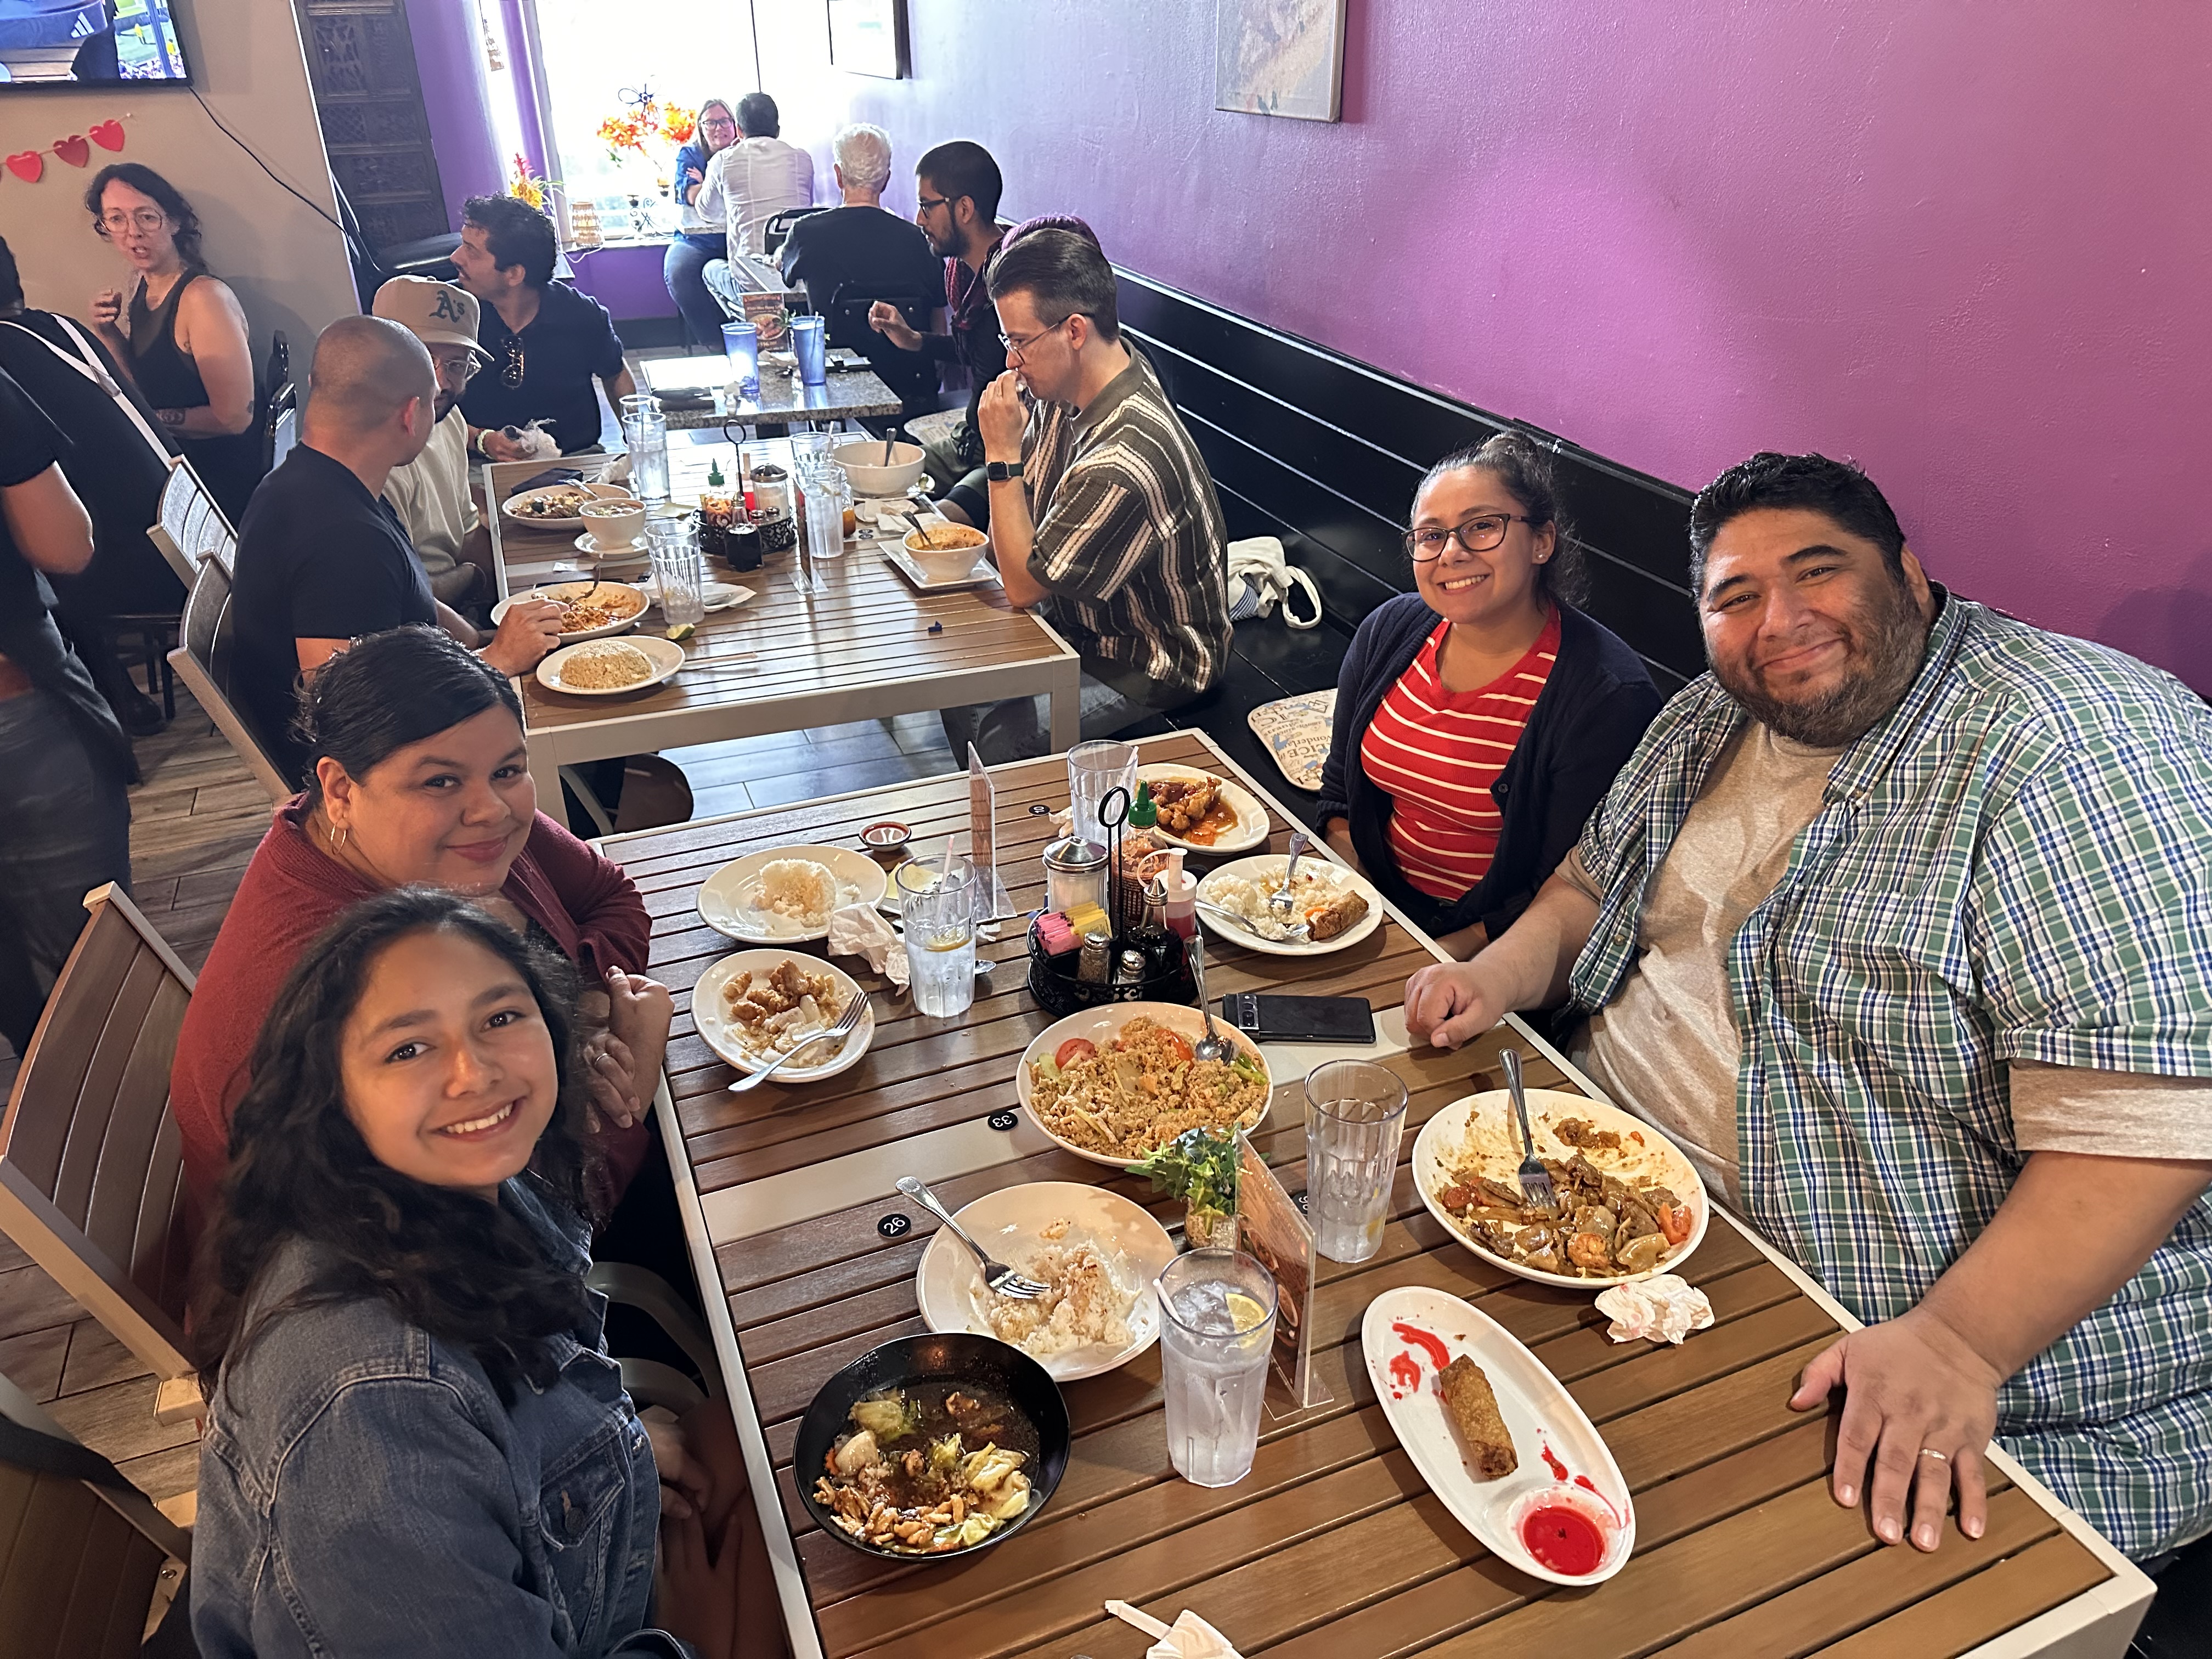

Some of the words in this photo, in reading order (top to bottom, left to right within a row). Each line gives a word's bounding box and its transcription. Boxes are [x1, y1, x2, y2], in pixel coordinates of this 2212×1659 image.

[428, 290, 465, 323] A's
[1285, 736, 1331, 748] onderla
[1287, 743, 1330, 758] LICE
[992, 1115, 1012, 1127] 33
[884, 1217, 905, 1234] 26
